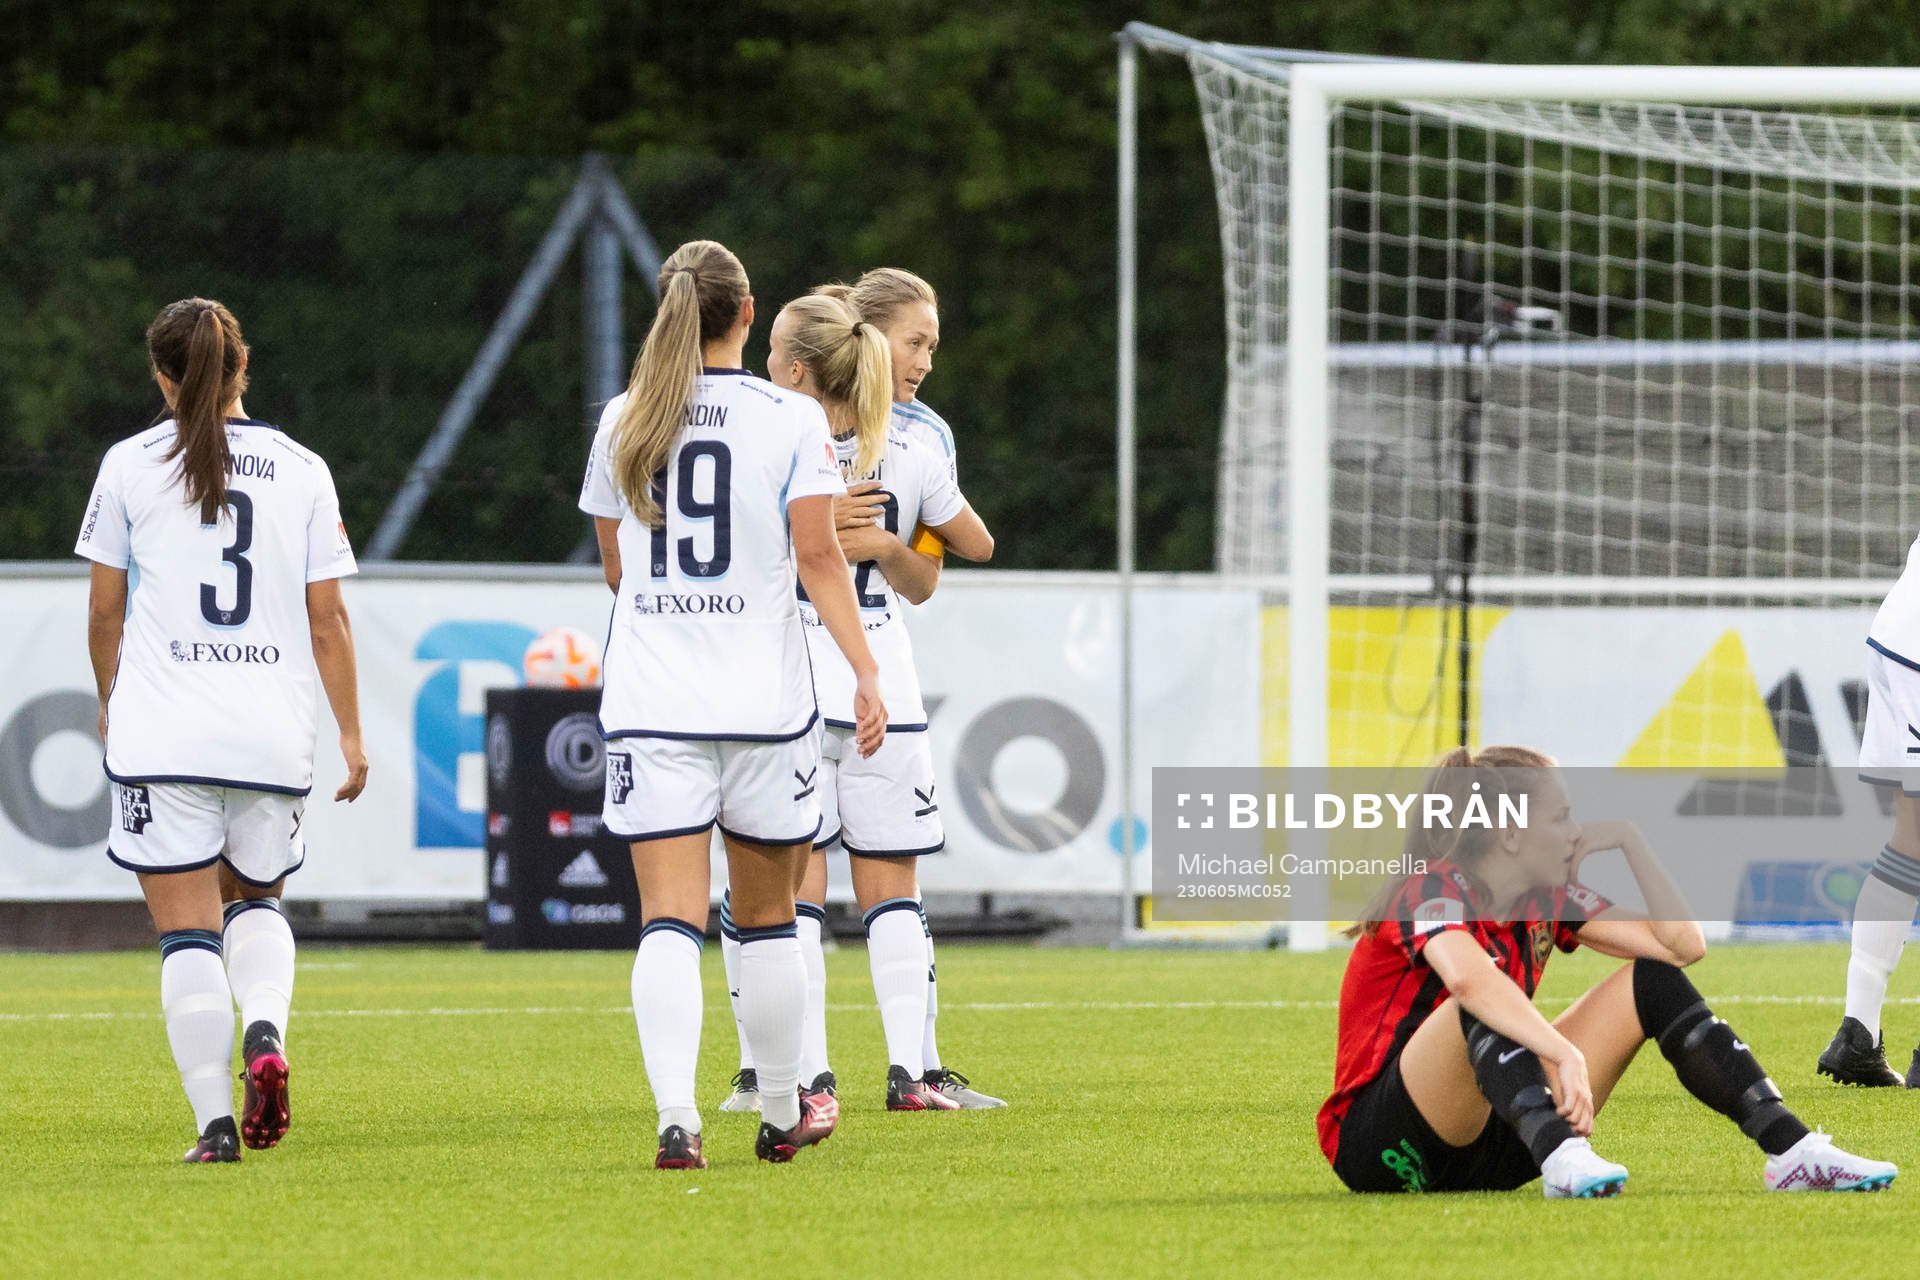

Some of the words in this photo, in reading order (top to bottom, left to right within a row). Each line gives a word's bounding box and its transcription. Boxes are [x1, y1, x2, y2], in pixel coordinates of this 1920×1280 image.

[651, 439, 732, 579] 19
[199, 489, 254, 627] 3
[655, 594, 745, 615] FXORO
[192, 643, 280, 665] FXORO
